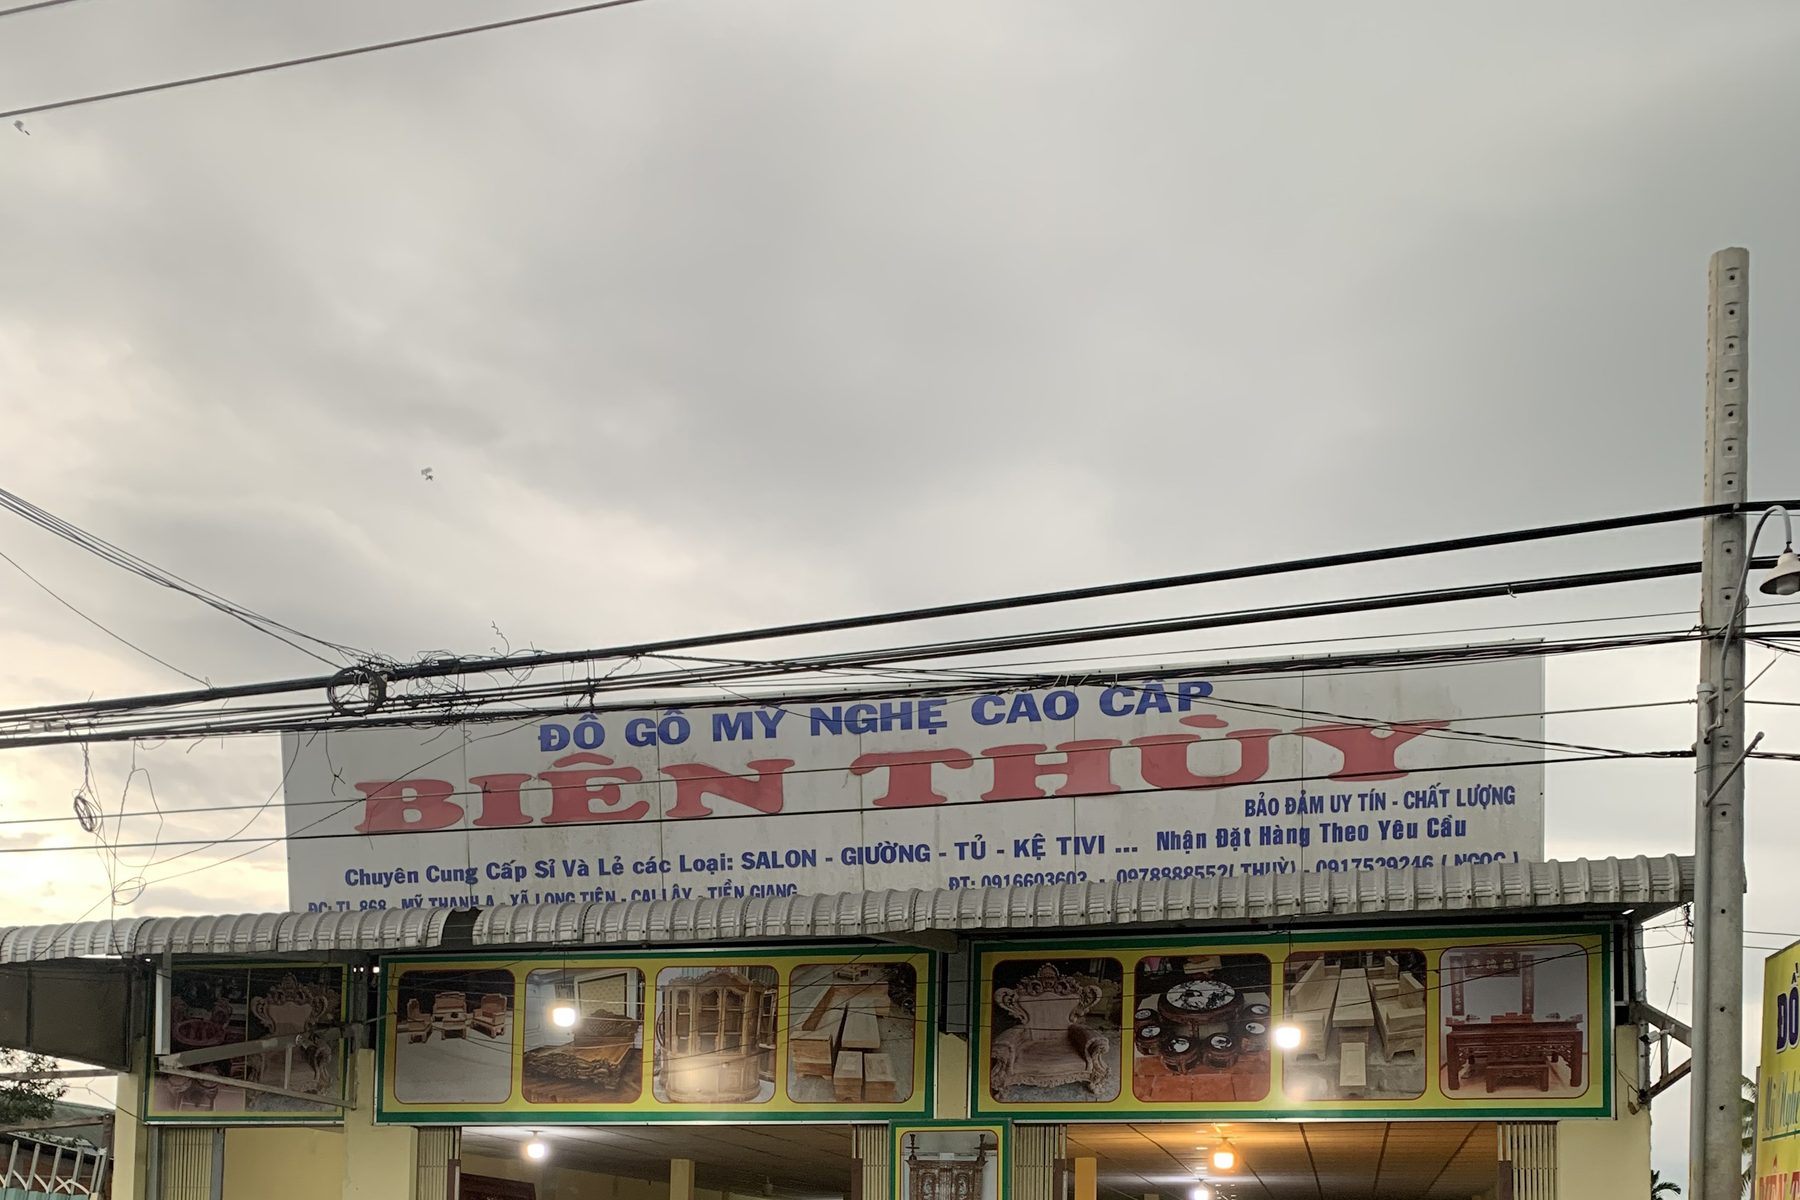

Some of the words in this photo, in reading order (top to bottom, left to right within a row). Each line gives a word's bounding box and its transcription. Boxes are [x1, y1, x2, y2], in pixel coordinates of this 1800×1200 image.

[810, 699, 948, 736] NGHỆ
[971, 690, 1080, 726] CAO
[354, 752, 795, 834] BIÊN
[1245, 791, 1280, 818] BẢO
[1285, 789, 1324, 815] ĐẢM
[1330, 794, 1352, 813] UY
[1358, 788, 1386, 812] TÍN
[1403, 782, 1450, 810] CHẤT
[1456, 783, 1516, 810] LƯỢNG
[1156, 830, 1207, 855] Nhận
[1216, 827, 1251, 852] Đặt
[1259, 824, 1311, 848] Hàng
[1319, 823, 1369, 844] Theo
[1378, 819, 1419, 841] Yêu
[1426, 814, 1467, 839] Cầu
[345, 868, 419, 889] Chuyên
[426, 864, 478, 885] Cung
[486, 859, 527, 882] Cấp
[562, 859, 589, 878] Và
[599, 856, 624, 876] Lẻ
[632, 856, 671, 875] các
[679, 852, 733, 876] Loại:
[741, 849, 817, 871] SALON
[841, 840, 930, 866] GIƯỜNG
[954, 833, 986, 861] TỦ
[1013, 833, 1046, 861] KỆ
[1056, 835, 1105, 856] TIVI
